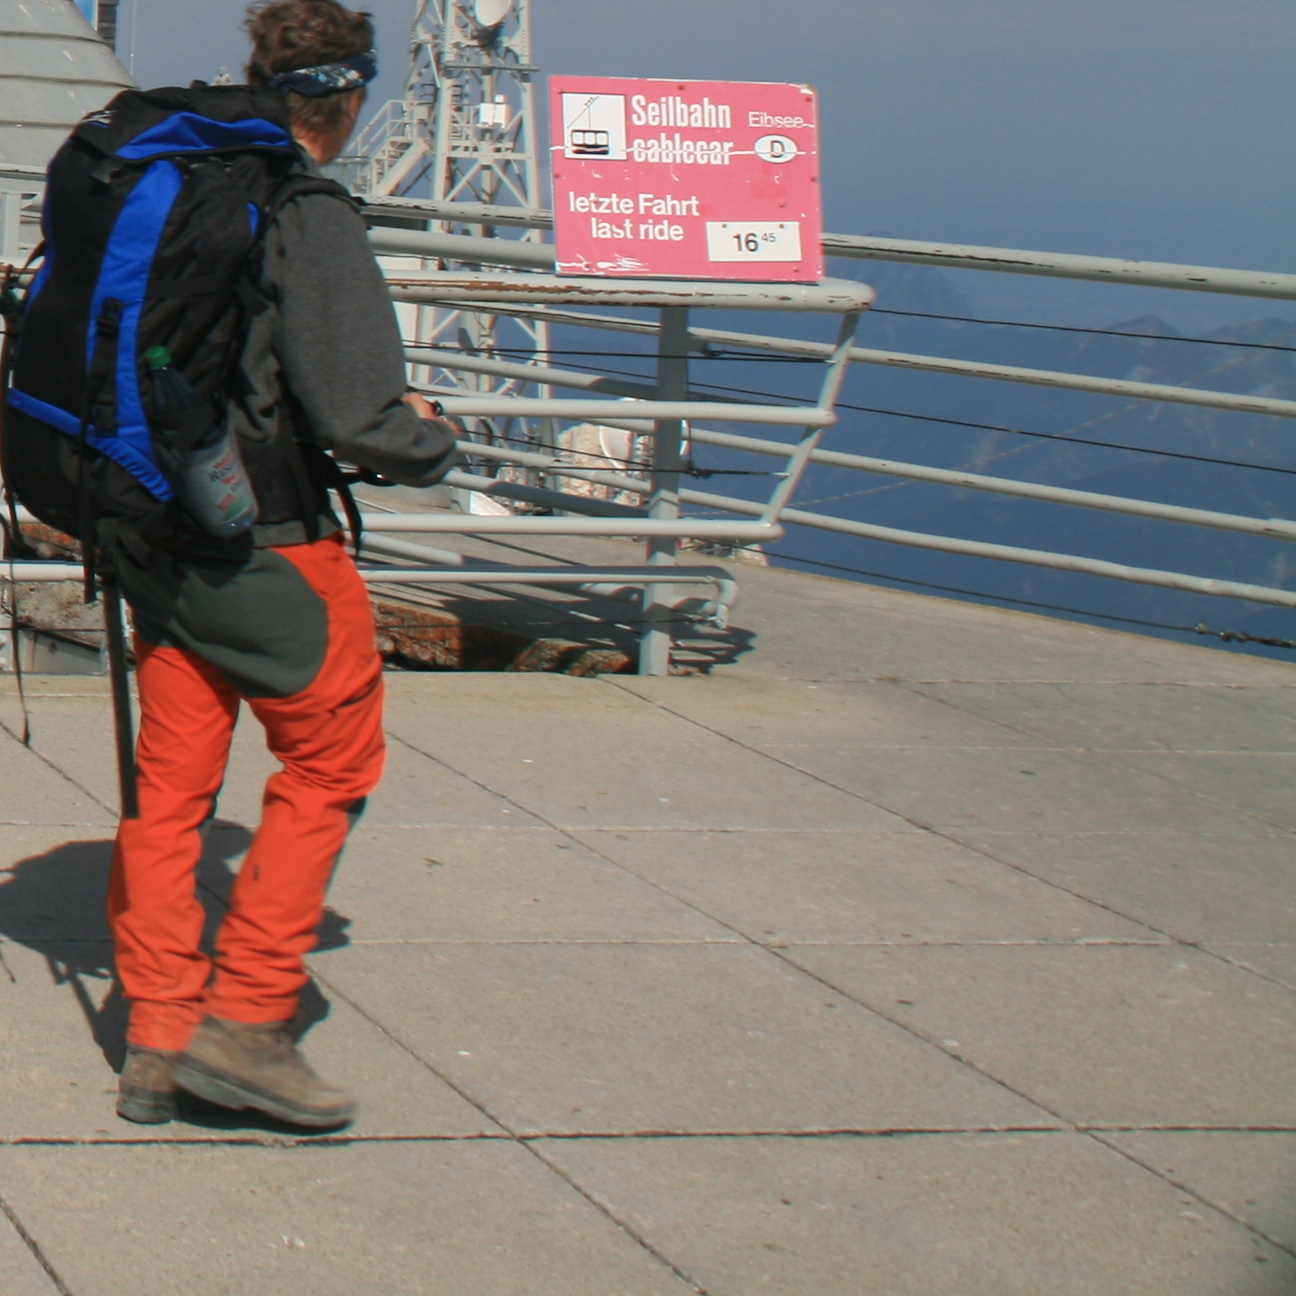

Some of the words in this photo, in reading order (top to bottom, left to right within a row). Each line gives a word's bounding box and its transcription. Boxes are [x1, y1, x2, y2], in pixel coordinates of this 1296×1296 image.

[631, 94, 732, 129] Seilbahn
[748, 111, 804, 130] Eibsee
[632, 133, 735, 165] cablecar
[768, 139, 785, 159] D
[569, 191, 635, 215] letzte
[639, 194, 700, 217] Fahrt
[591, 217, 633, 240] last
[639, 219, 685, 241] ride
